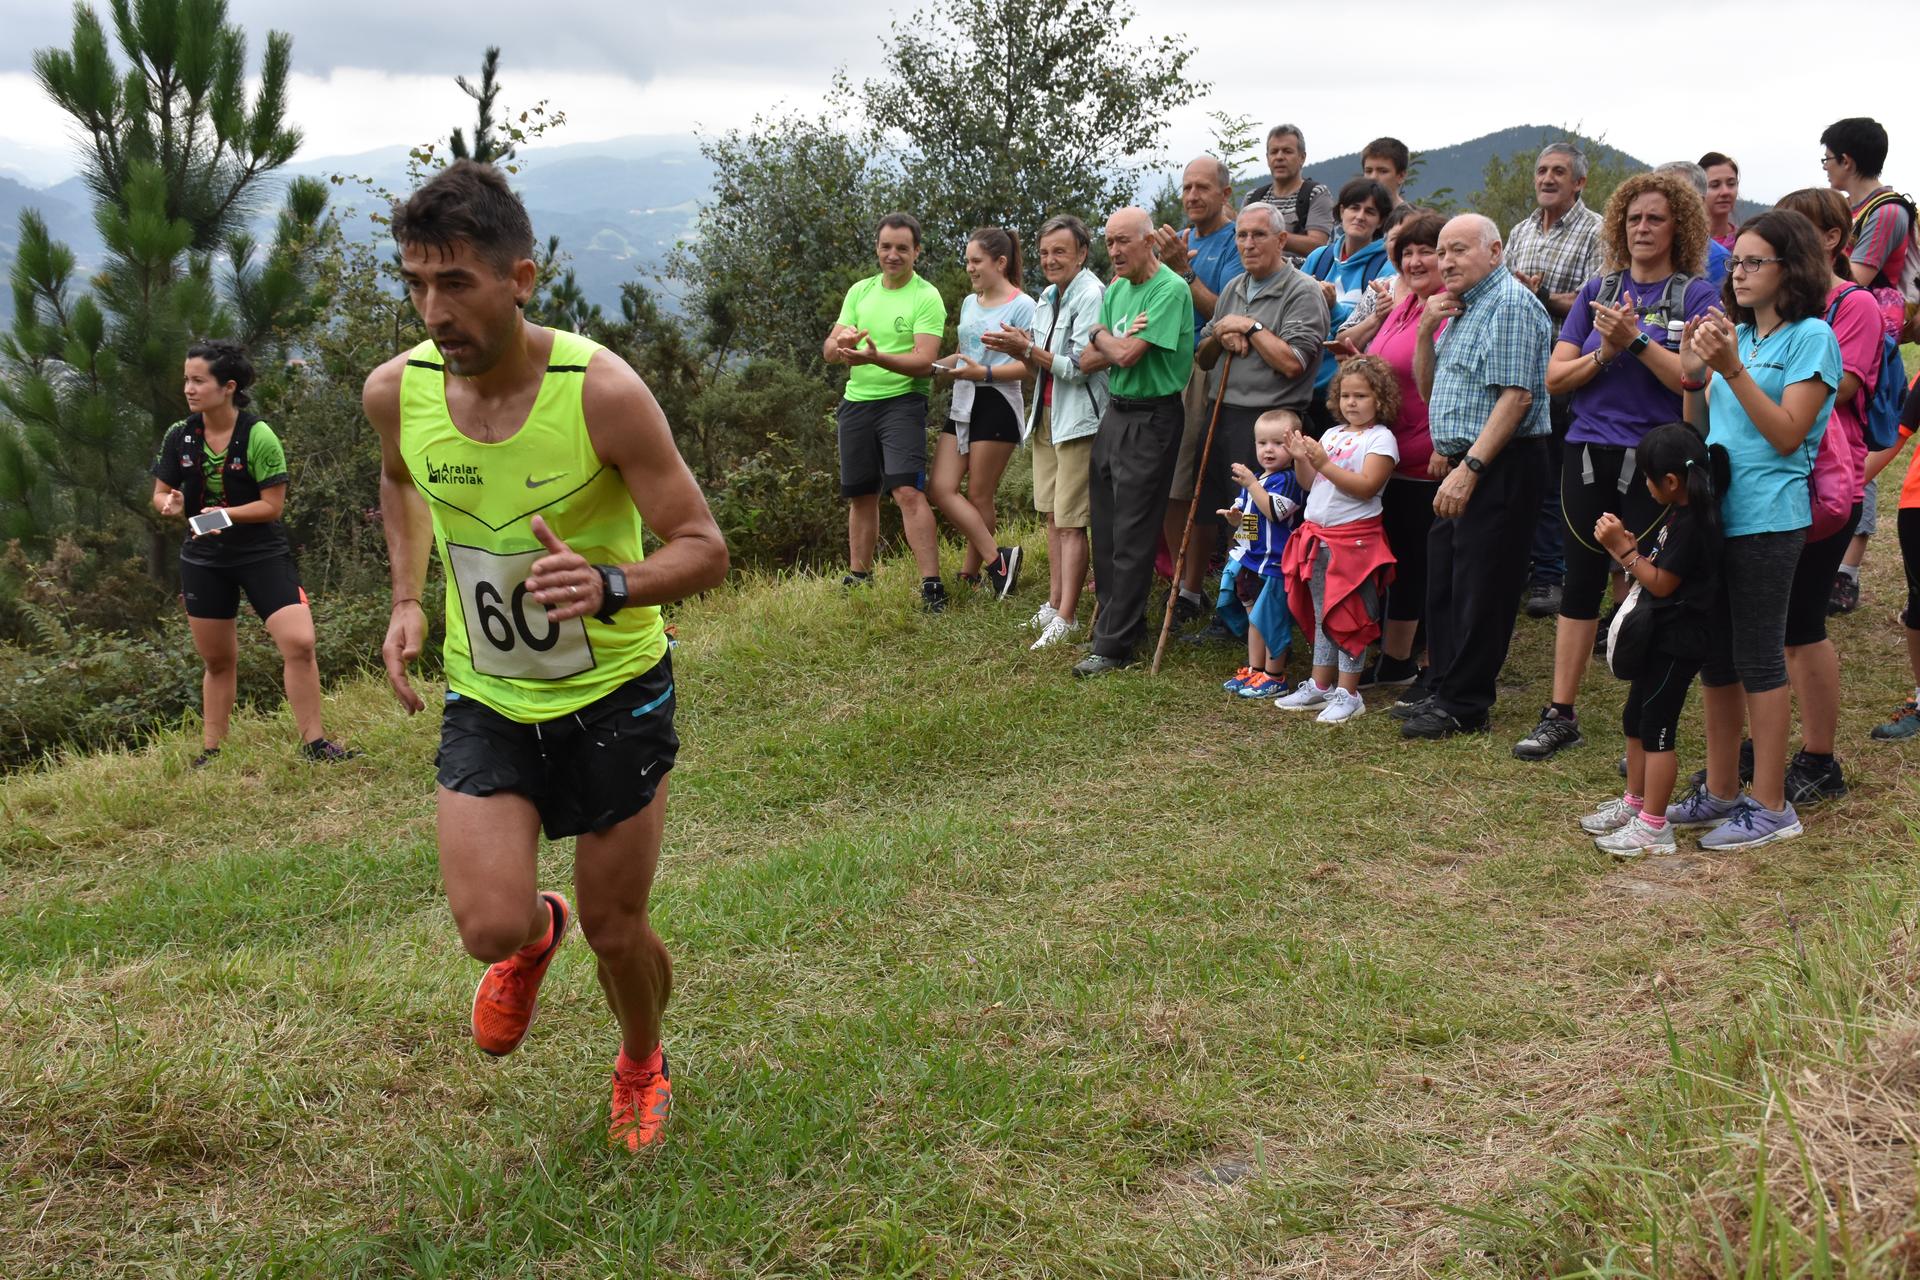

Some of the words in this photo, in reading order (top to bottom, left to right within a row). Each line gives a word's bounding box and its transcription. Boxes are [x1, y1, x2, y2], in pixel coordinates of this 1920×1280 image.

[441, 462, 478, 475] Aralar
[441, 474, 484, 485] Kirolak
[475, 580, 560, 652] 60
